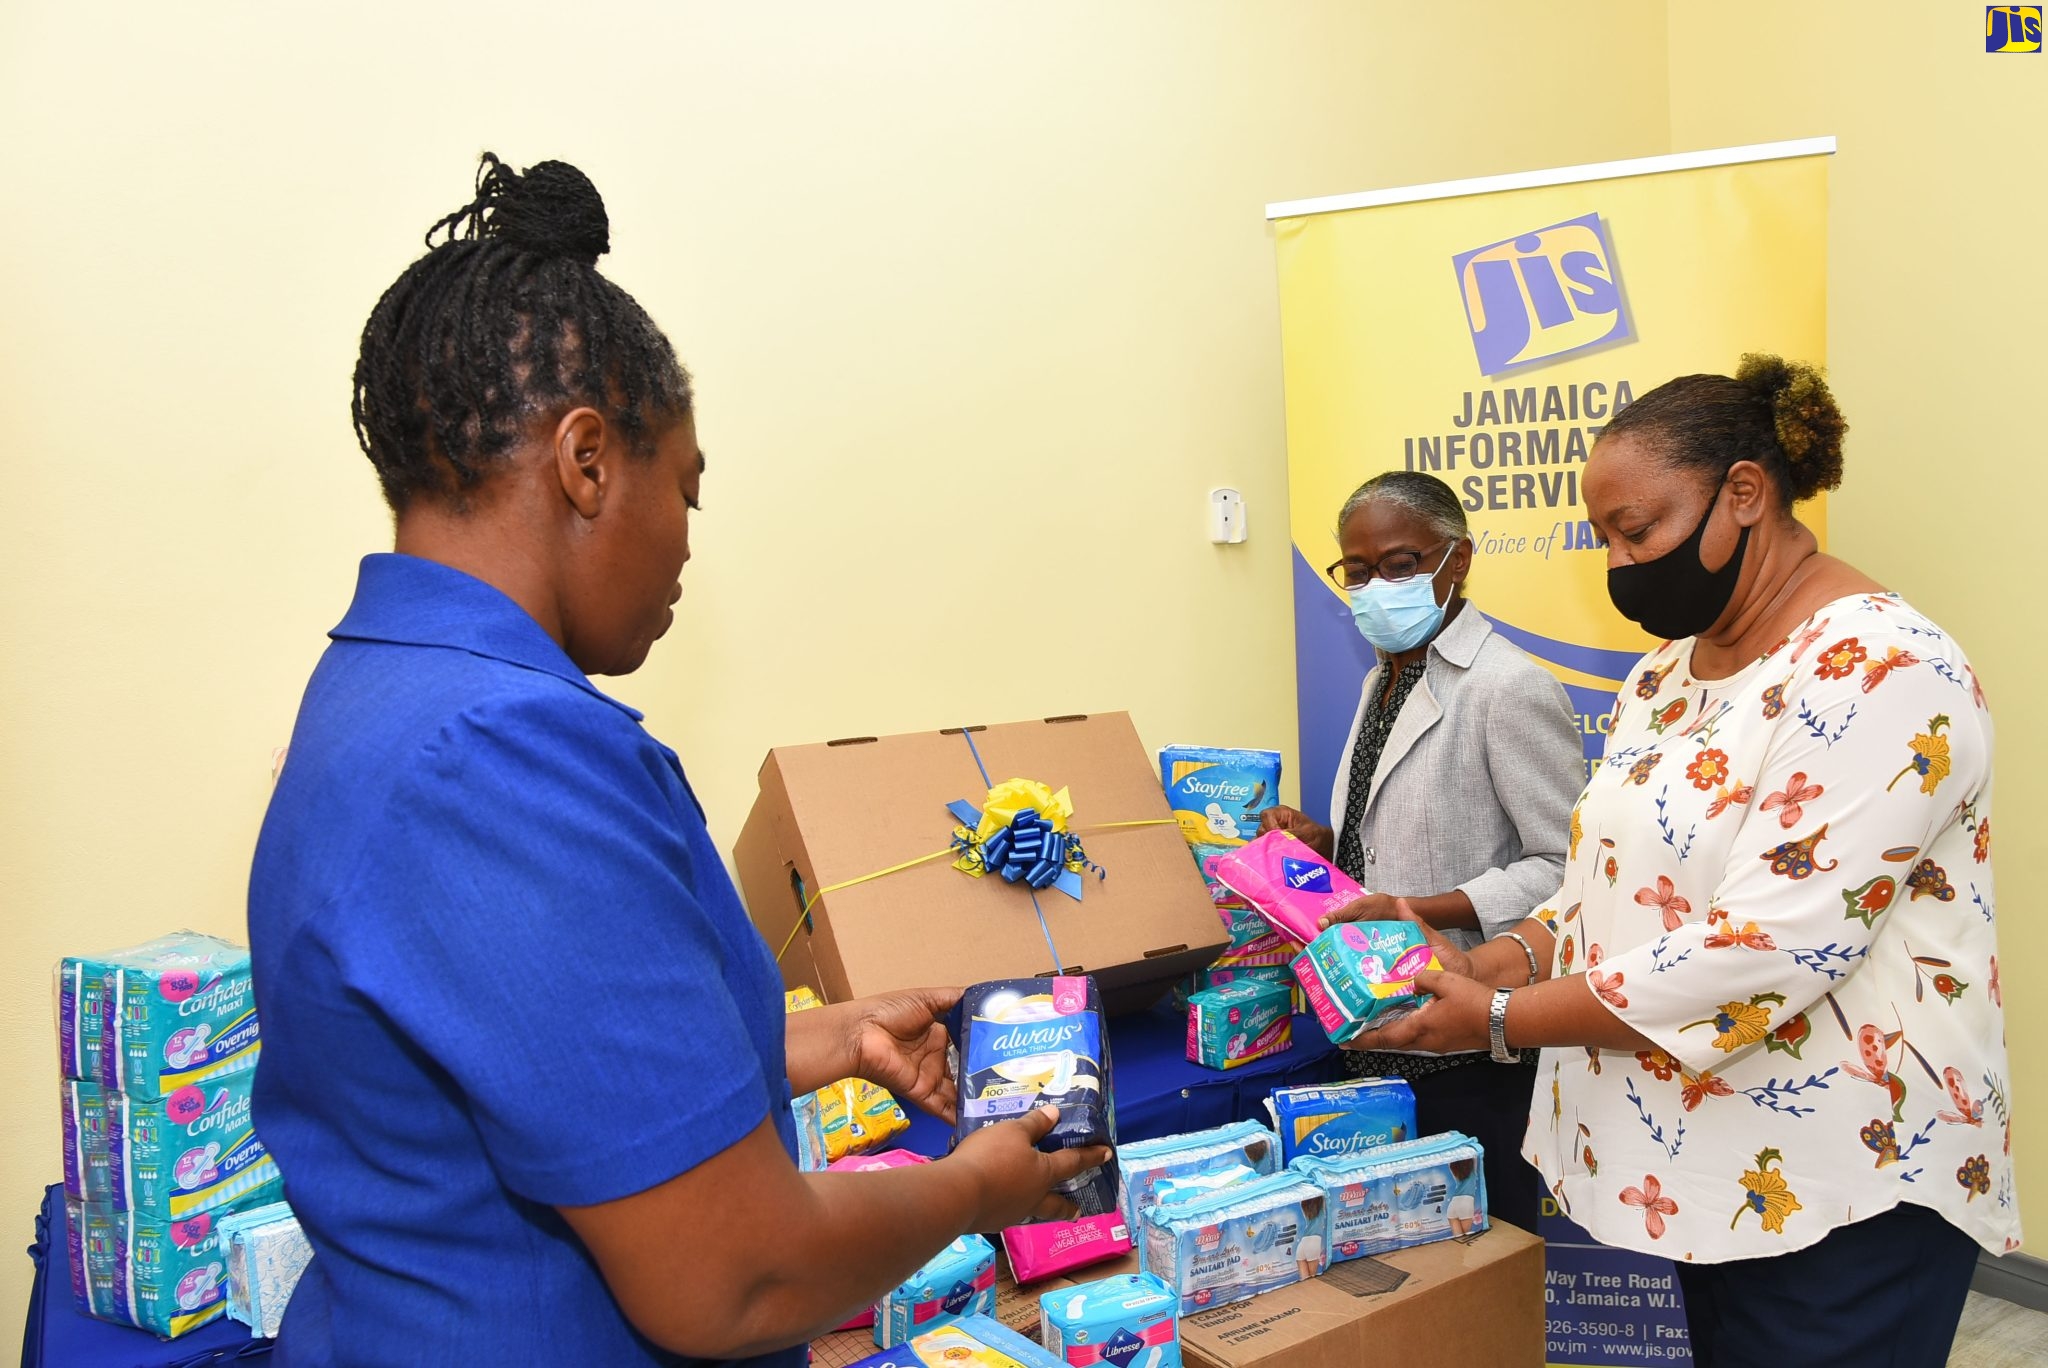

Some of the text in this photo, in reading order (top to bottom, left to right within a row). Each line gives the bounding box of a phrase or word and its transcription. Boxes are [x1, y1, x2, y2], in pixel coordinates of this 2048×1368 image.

[1453, 381, 1634, 427] JAMAICA
[1405, 426, 1602, 472] INFORMA
[1462, 471, 1577, 512] SERVI
[1467, 521, 1609, 560] Voice of JA
[1183, 777, 1249, 798] Stayfree
[1289, 866, 1326, 888] Libresse
[1231, 920, 1266, 932] Confide
[1248, 935, 1280, 953] Regular
[179, 977, 254, 1016] Confiden
[217, 995, 243, 1017] Maxi
[1243, 1005, 1278, 1029] Confidence
[216, 1021, 259, 1054] Overnig
[993, 1024, 1074, 1051] always
[1256, 1022, 1282, 1048] Regular
[1003, 1045, 1047, 1057] ULTRA THIN
[187, 1094, 250, 1137] Confide
[986, 1099, 997, 1114] 5
[225, 1110, 250, 1134] Maxi
[1309, 1132, 1388, 1154] Stayfree
[1057, 1222, 1096, 1240] FEEL SECURE
[1335, 1212, 1390, 1229] SANITARY PAD
[1055, 1237, 1075, 1249] WEAR
[1190, 1255, 1241, 1277] SANITARY PAD
[1583, 1272, 1621, 1288] Tree
[1629, 1274, 1672, 1290] Road
[1566, 1290, 1641, 1307] Jamaica
[1647, 1294, 1681, 1309] W.I.
[1197, 1312, 1243, 1329] TENDIDO
[1198, 1309, 1230, 1322] CAJAS
[1231, 1301, 1253, 1311] POR
[1217, 1307, 1302, 1341] ARRUME MAXIMO
[1235, 1327, 1272, 1343] ESTIBA
[1656, 1325, 1688, 1339] Fax:
[1105, 1341, 1141, 1358] Libresse
